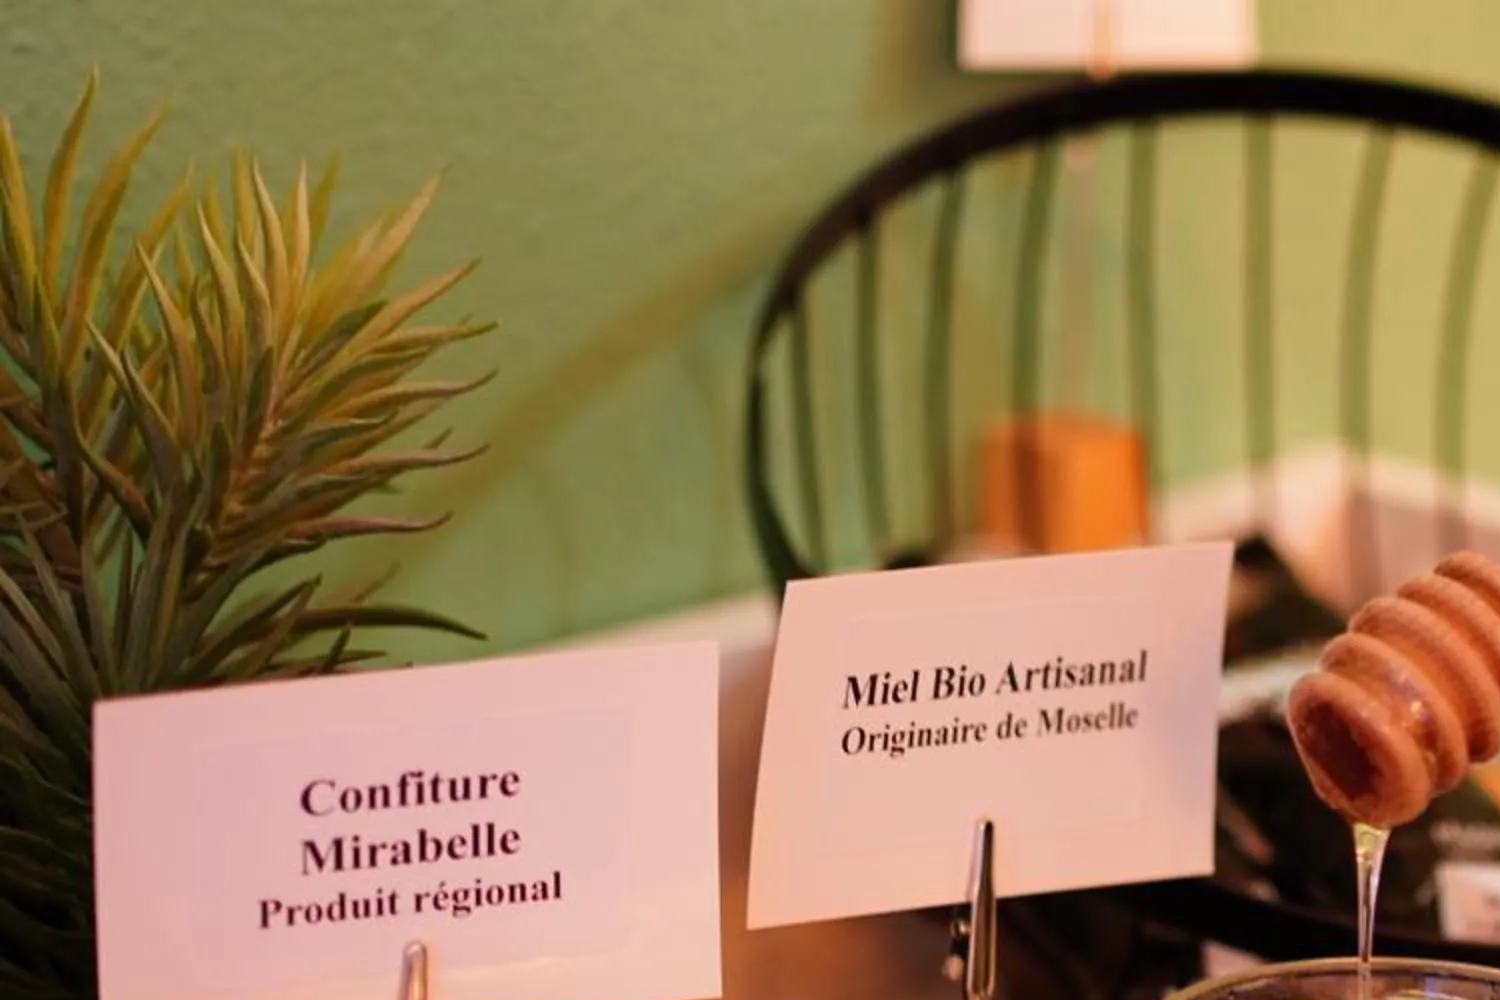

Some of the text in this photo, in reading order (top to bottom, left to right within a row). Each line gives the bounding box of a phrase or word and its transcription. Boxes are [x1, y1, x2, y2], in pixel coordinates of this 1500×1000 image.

[841, 649, 1149, 710] Miel Bio Artisanal
[840, 702, 1140, 758] Originaire de Moselle
[300, 769, 521, 817] Confiture
[300, 822, 522, 877] Mirabelle
[258, 870, 562, 930] Produit régional
